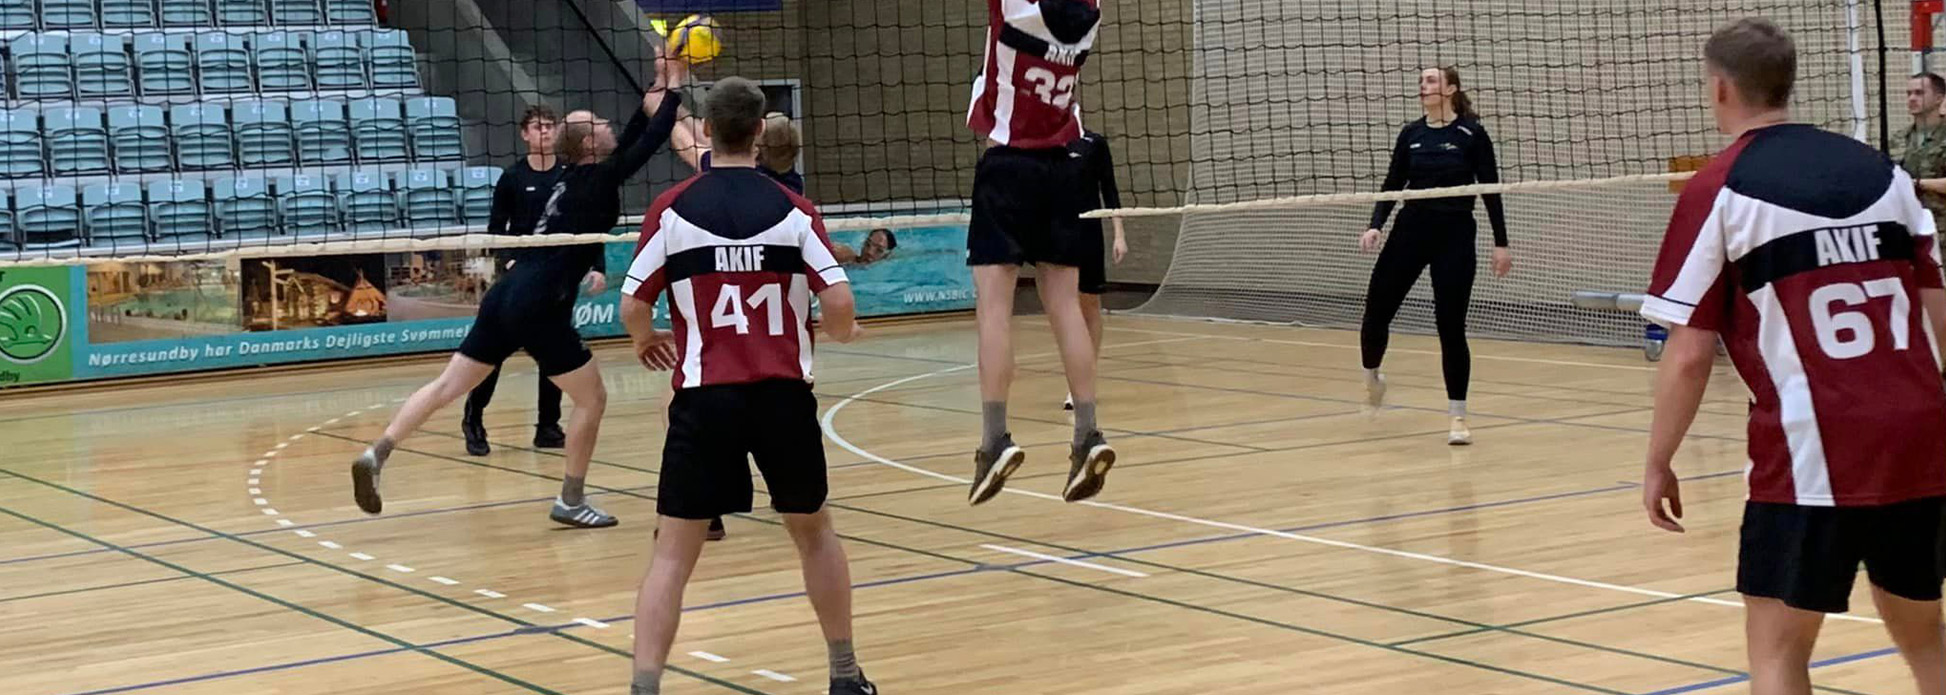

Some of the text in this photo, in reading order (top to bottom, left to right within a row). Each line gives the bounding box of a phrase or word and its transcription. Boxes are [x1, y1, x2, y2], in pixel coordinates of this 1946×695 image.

[1022, 66, 1075, 110] 32
[715, 245, 764, 272] AKIF
[1814, 224, 1882, 267] AKIF
[711, 283, 784, 336] 41
[1809, 277, 1910, 360] 67
[88, 346, 199, 367] Nørresundby
[205, 344, 232, 357] har
[239, 336, 320, 355] Danmarks
[325, 332, 396, 349] Dejligste
